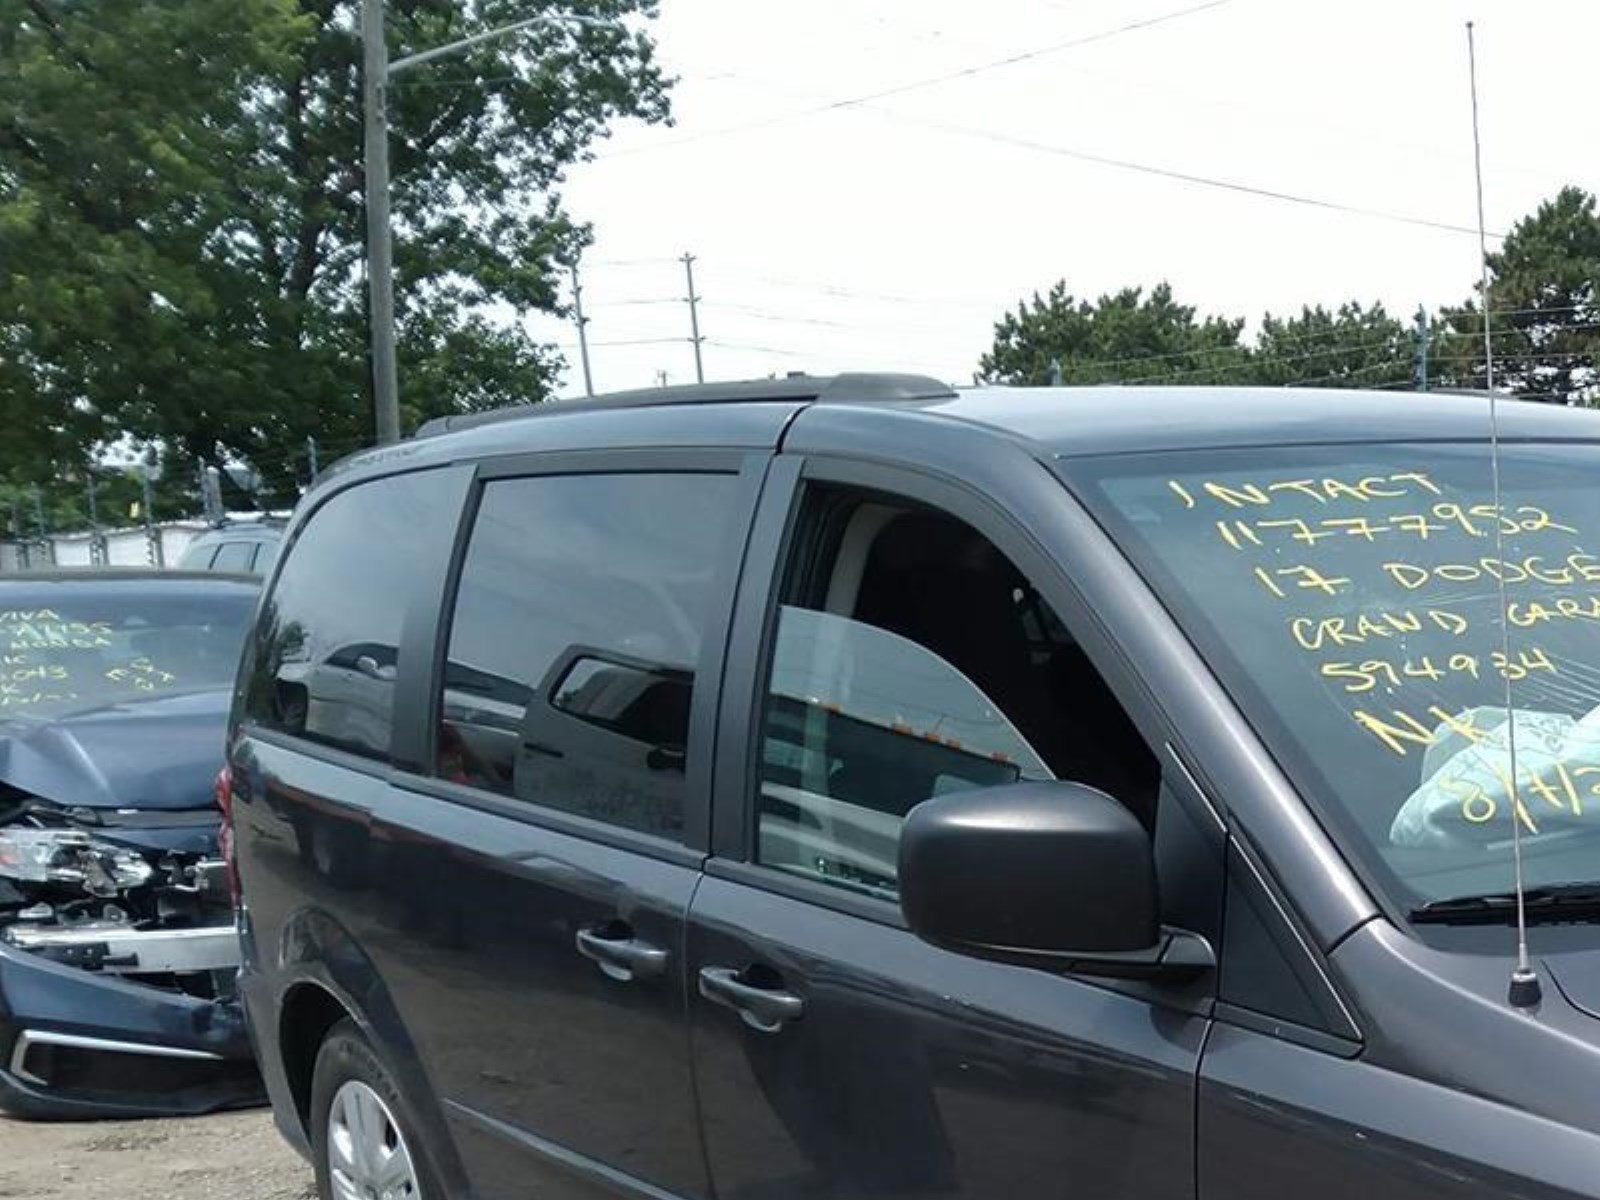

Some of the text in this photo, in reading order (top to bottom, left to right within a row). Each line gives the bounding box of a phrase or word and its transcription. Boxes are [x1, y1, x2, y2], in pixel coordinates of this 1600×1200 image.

[1168, 472, 1442, 508] INTACT
[1216, 502, 1578, 550] 11777952
[1254, 564, 1351, 598] 17
[1322, 647, 1557, 692] 594934
